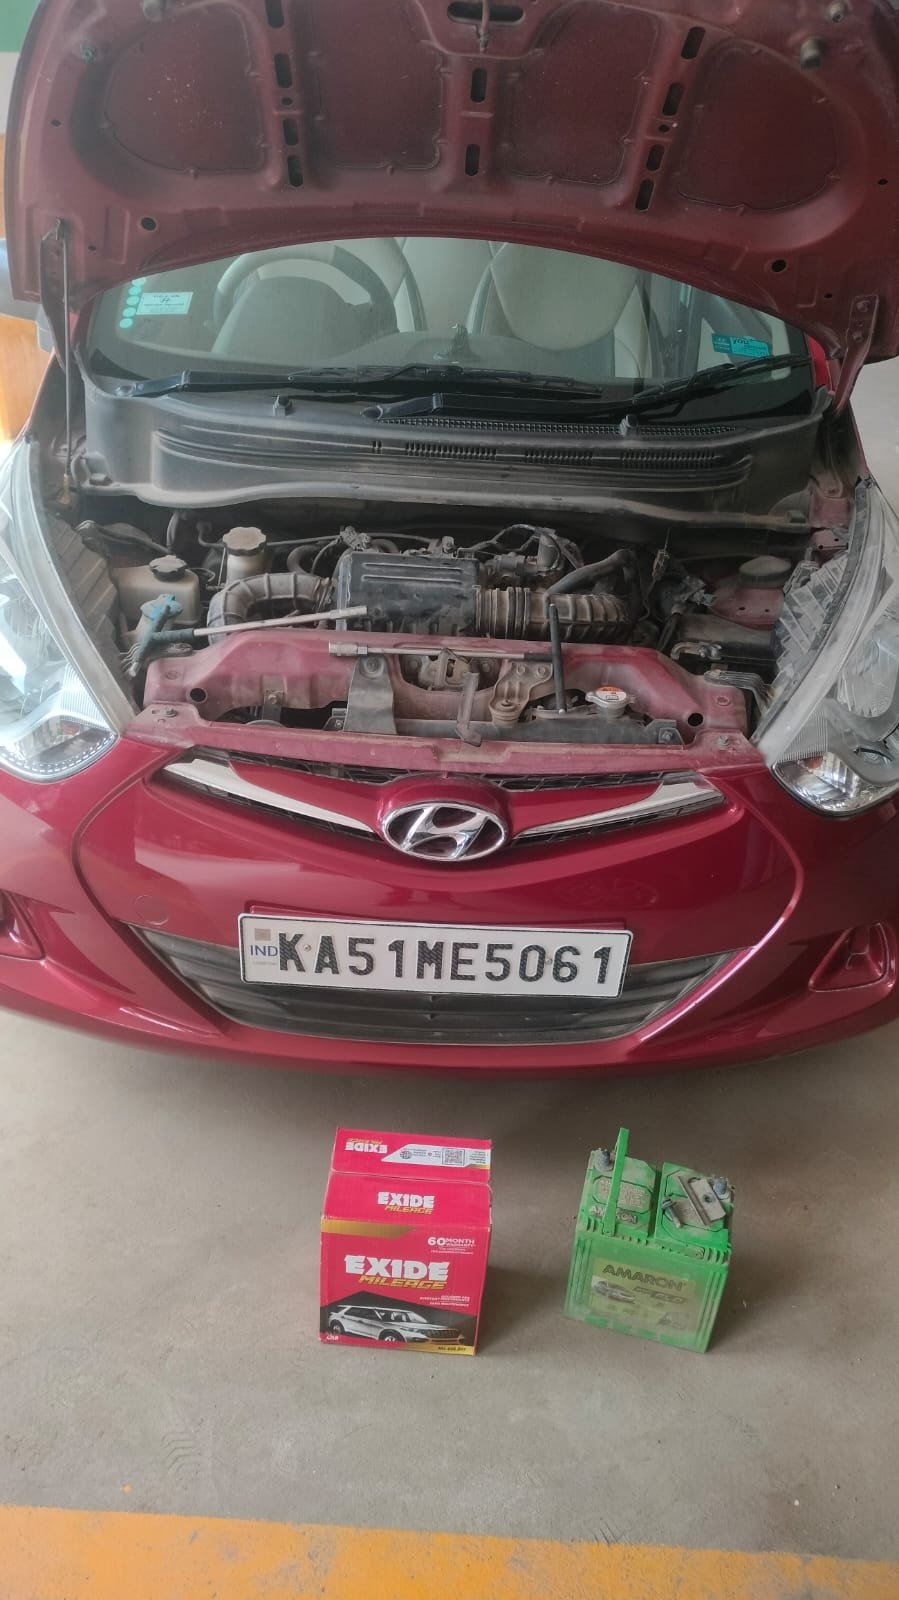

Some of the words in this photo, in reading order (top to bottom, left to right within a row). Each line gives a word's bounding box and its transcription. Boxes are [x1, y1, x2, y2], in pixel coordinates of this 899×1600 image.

[250, 944, 278, 957] IND
[278, 932, 612, 985] KA51ME5061
[344, 1140, 388, 1154] EXIDE
[377, 1191, 436, 1208] EXIDE
[384, 1205, 434, 1215] MILEAGE
[589, 1204, 638, 1224] AMRON
[427, 1236, 446, 1246] 60
[445, 1237, 475, 1245] MONTH
[344, 1254, 450, 1282] EXIDE
[358, 1275, 448, 1290] MILEAGE
[602, 1264, 683, 1291] AMARON
